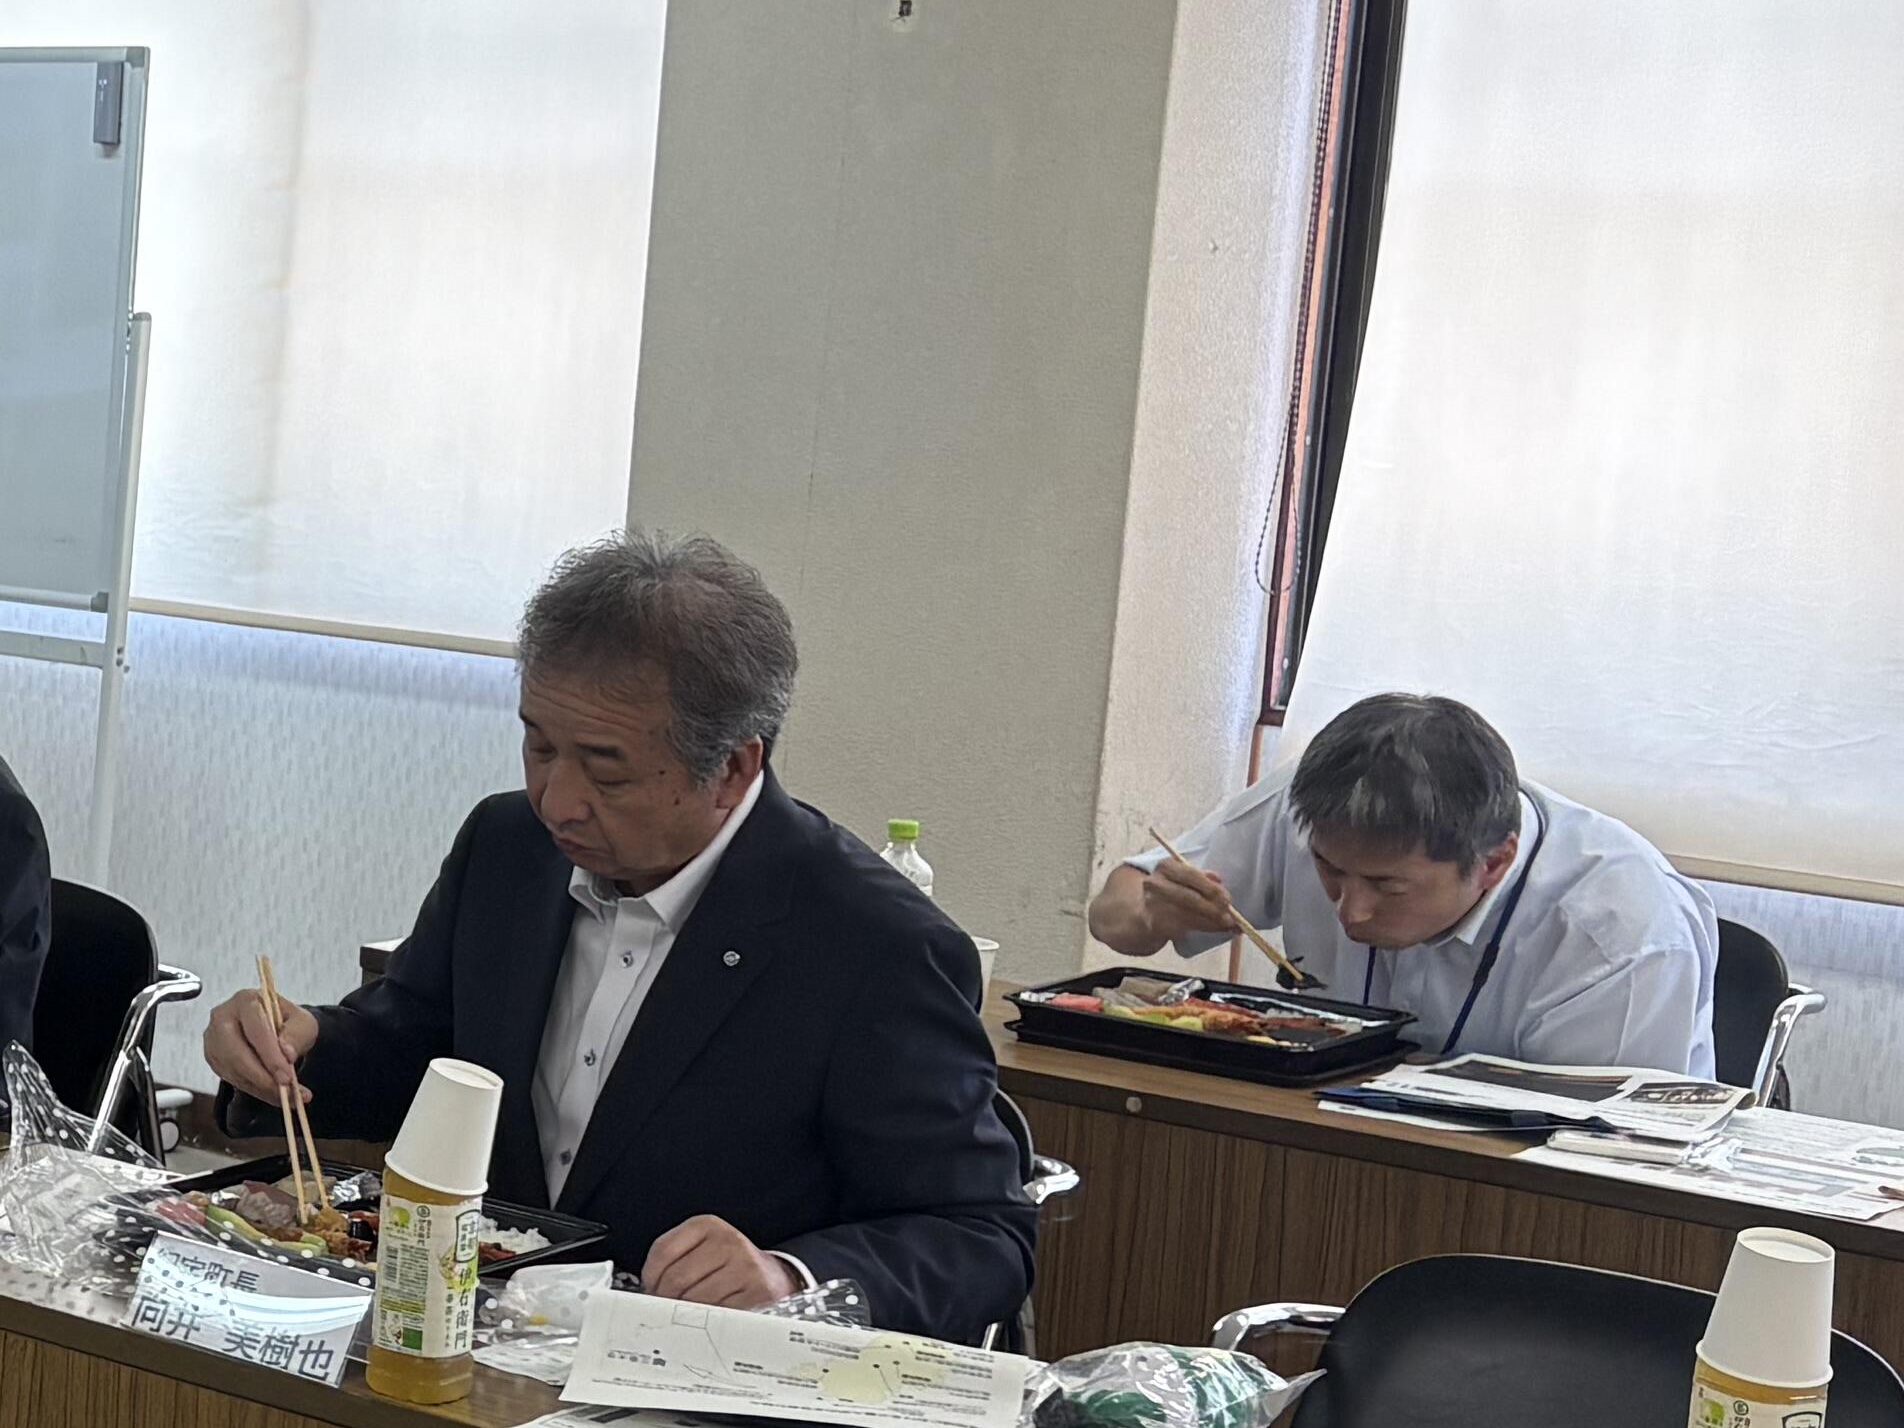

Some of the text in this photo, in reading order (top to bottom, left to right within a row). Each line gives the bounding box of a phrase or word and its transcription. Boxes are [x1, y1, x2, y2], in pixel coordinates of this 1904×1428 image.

[131, 1291, 336, 1382] 向井 美樹也
